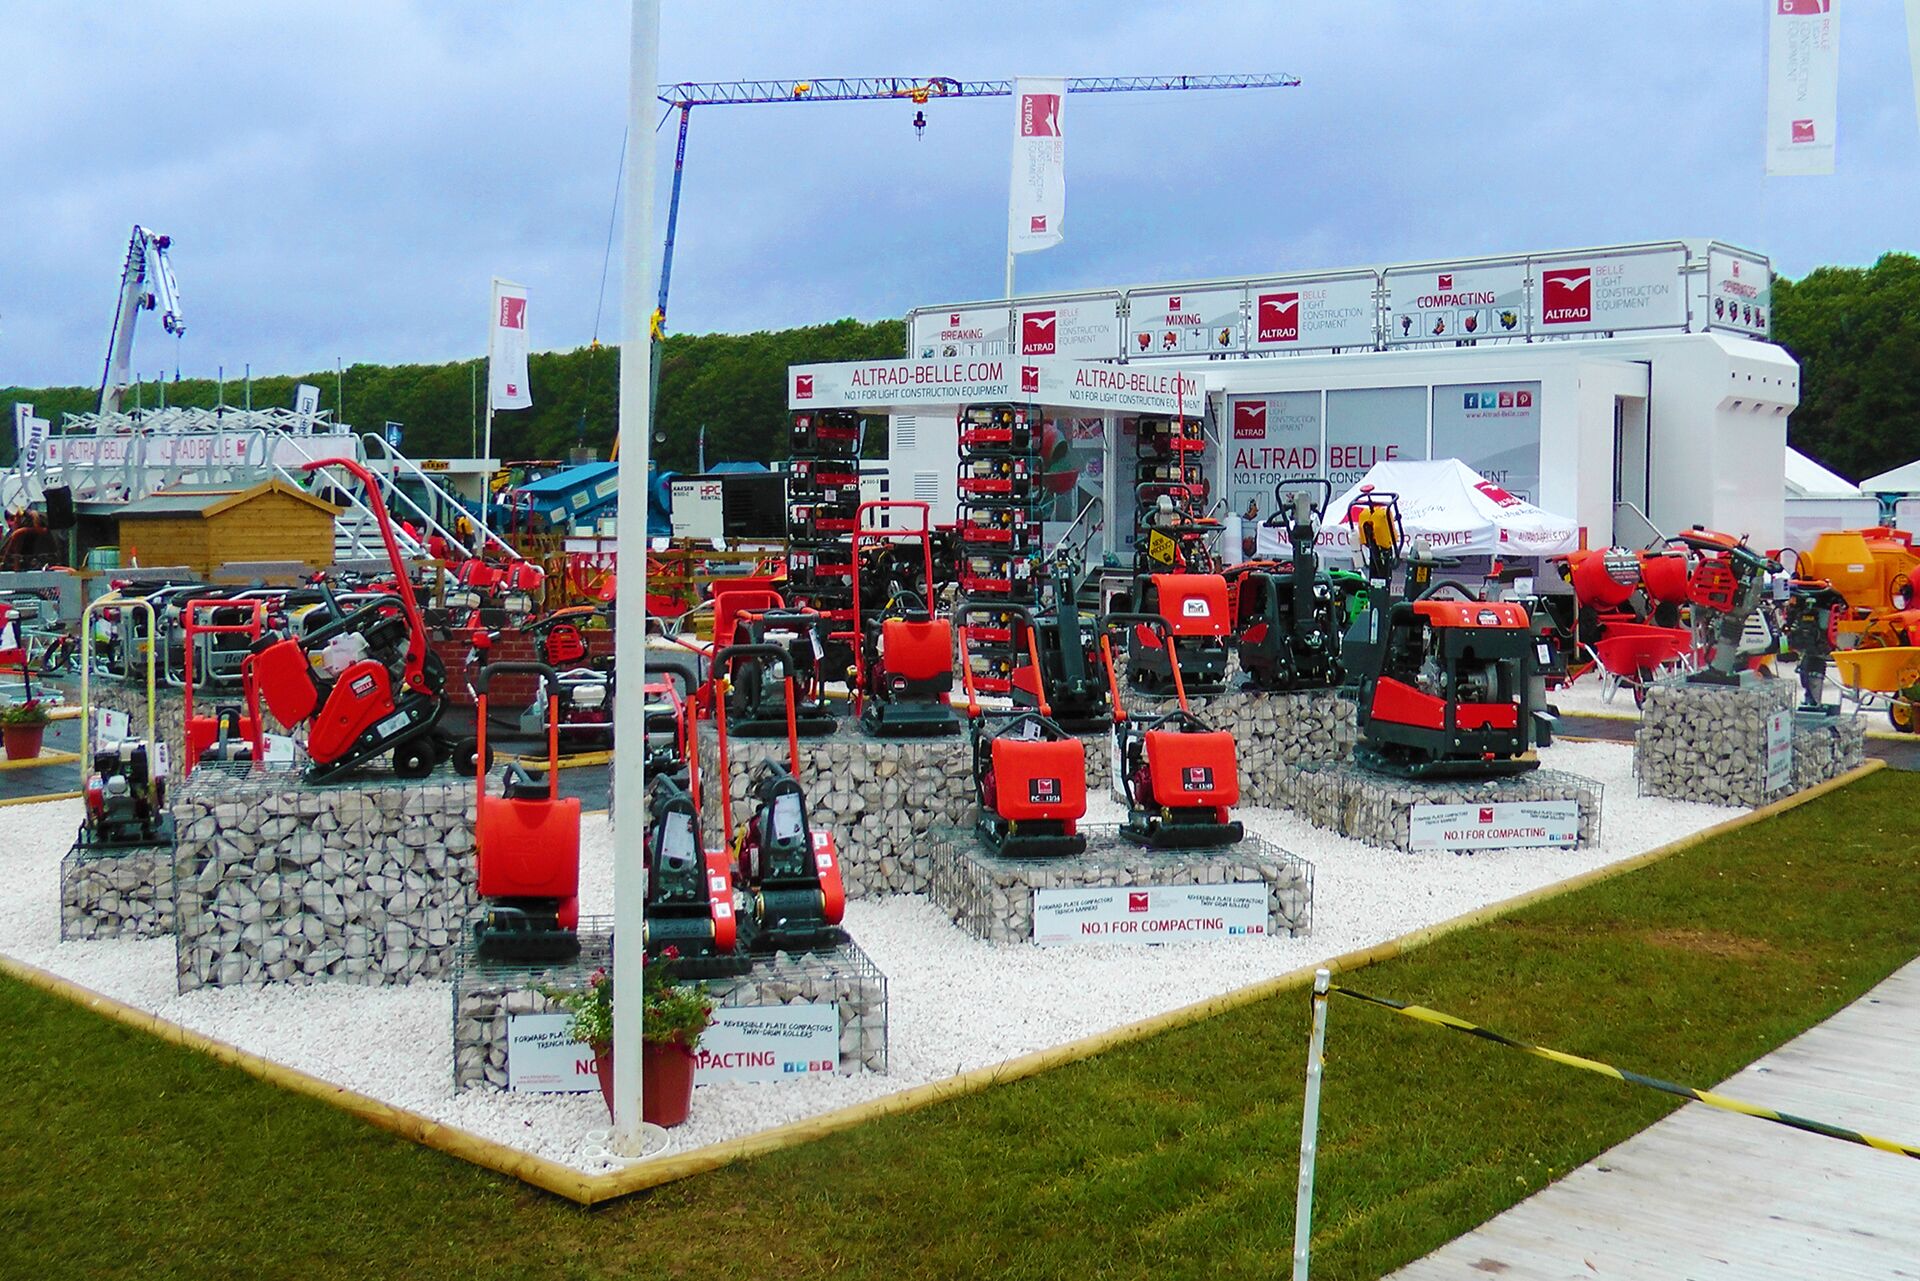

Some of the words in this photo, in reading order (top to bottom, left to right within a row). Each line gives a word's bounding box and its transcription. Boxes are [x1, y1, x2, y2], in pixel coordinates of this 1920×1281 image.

[1024, 96, 1032, 134] ALTRAD
[1595, 265, 1624, 276] BELLE
[1596, 276, 1622, 287] LIGHT
[1303, 290, 1327, 300] BELLE
[1595, 285, 1669, 298] CONSTRUCTION
[1303, 300, 1324, 310] LIGHT
[1417, 292, 1495, 308] COMPACTING
[1596, 298, 1650, 311] EQUIPMENT
[1059, 309, 1079, 318] BELLE
[1166, 313, 1201, 326] MIXING
[1302, 308, 1363, 320] CONSTRUCTION
[1545, 307, 1589, 320] ALTRAD
[1059, 325, 1110, 336] CONSTRUCTION
[1302, 319, 1348, 330] EQUIPMENT
[941, 328, 983, 341] BREAKING
[1260, 328, 1296, 339] ALTRAD
[1059, 335, 1097, 345] EQUIPMENT
[1024, 343, 1054, 353] ALTRAD
[851, 362, 1004, 387] ALTRAD-BELLE.COM
[1075, 368, 1198, 396] ALTRAD-BELLE.COM
[862, 390, 878, 399] FOR
[879, 388, 900, 399] LIGHT
[901, 387, 960, 398] CONSTRUCTION
[962, 385, 1009, 396] EQUIPMENT
[1085, 391, 1099, 401] FOR
[1100, 392, 1118, 402] LIGHT
[1118, 393, 1166, 407] CONSTRUCTION
[1236, 429, 1264, 437] ALTRAD
[1234, 448, 1317, 469] ALTRAD
[1234, 472, 1256, 485] NO.1
[1259, 472, 1281, 485] FOR
[700, 485, 721, 495] HPC
[1444, 830, 1464, 840] NO.1
[1466, 830, 1485, 840] FOR
[1487, 827, 1546, 839] COMPACTING
[1081, 921, 1108, 934] NO.1
[1112, 921, 1138, 933] FOR
[1141, 917, 1223, 932] COMPACTING
[723, 1020, 764, 1029] REVERSIBLE
[765, 1021, 787, 1030] PLATE
[788, 1022, 833, 1032] COMPACTORS
[514, 1032, 547, 1043] FORWARD
[549, 1031, 563, 1039] PLA
[782, 1029, 813, 1038] ROLLERS
[537, 1039, 564, 1049] TRENCH
[694, 1050, 776, 1070] PACTING
